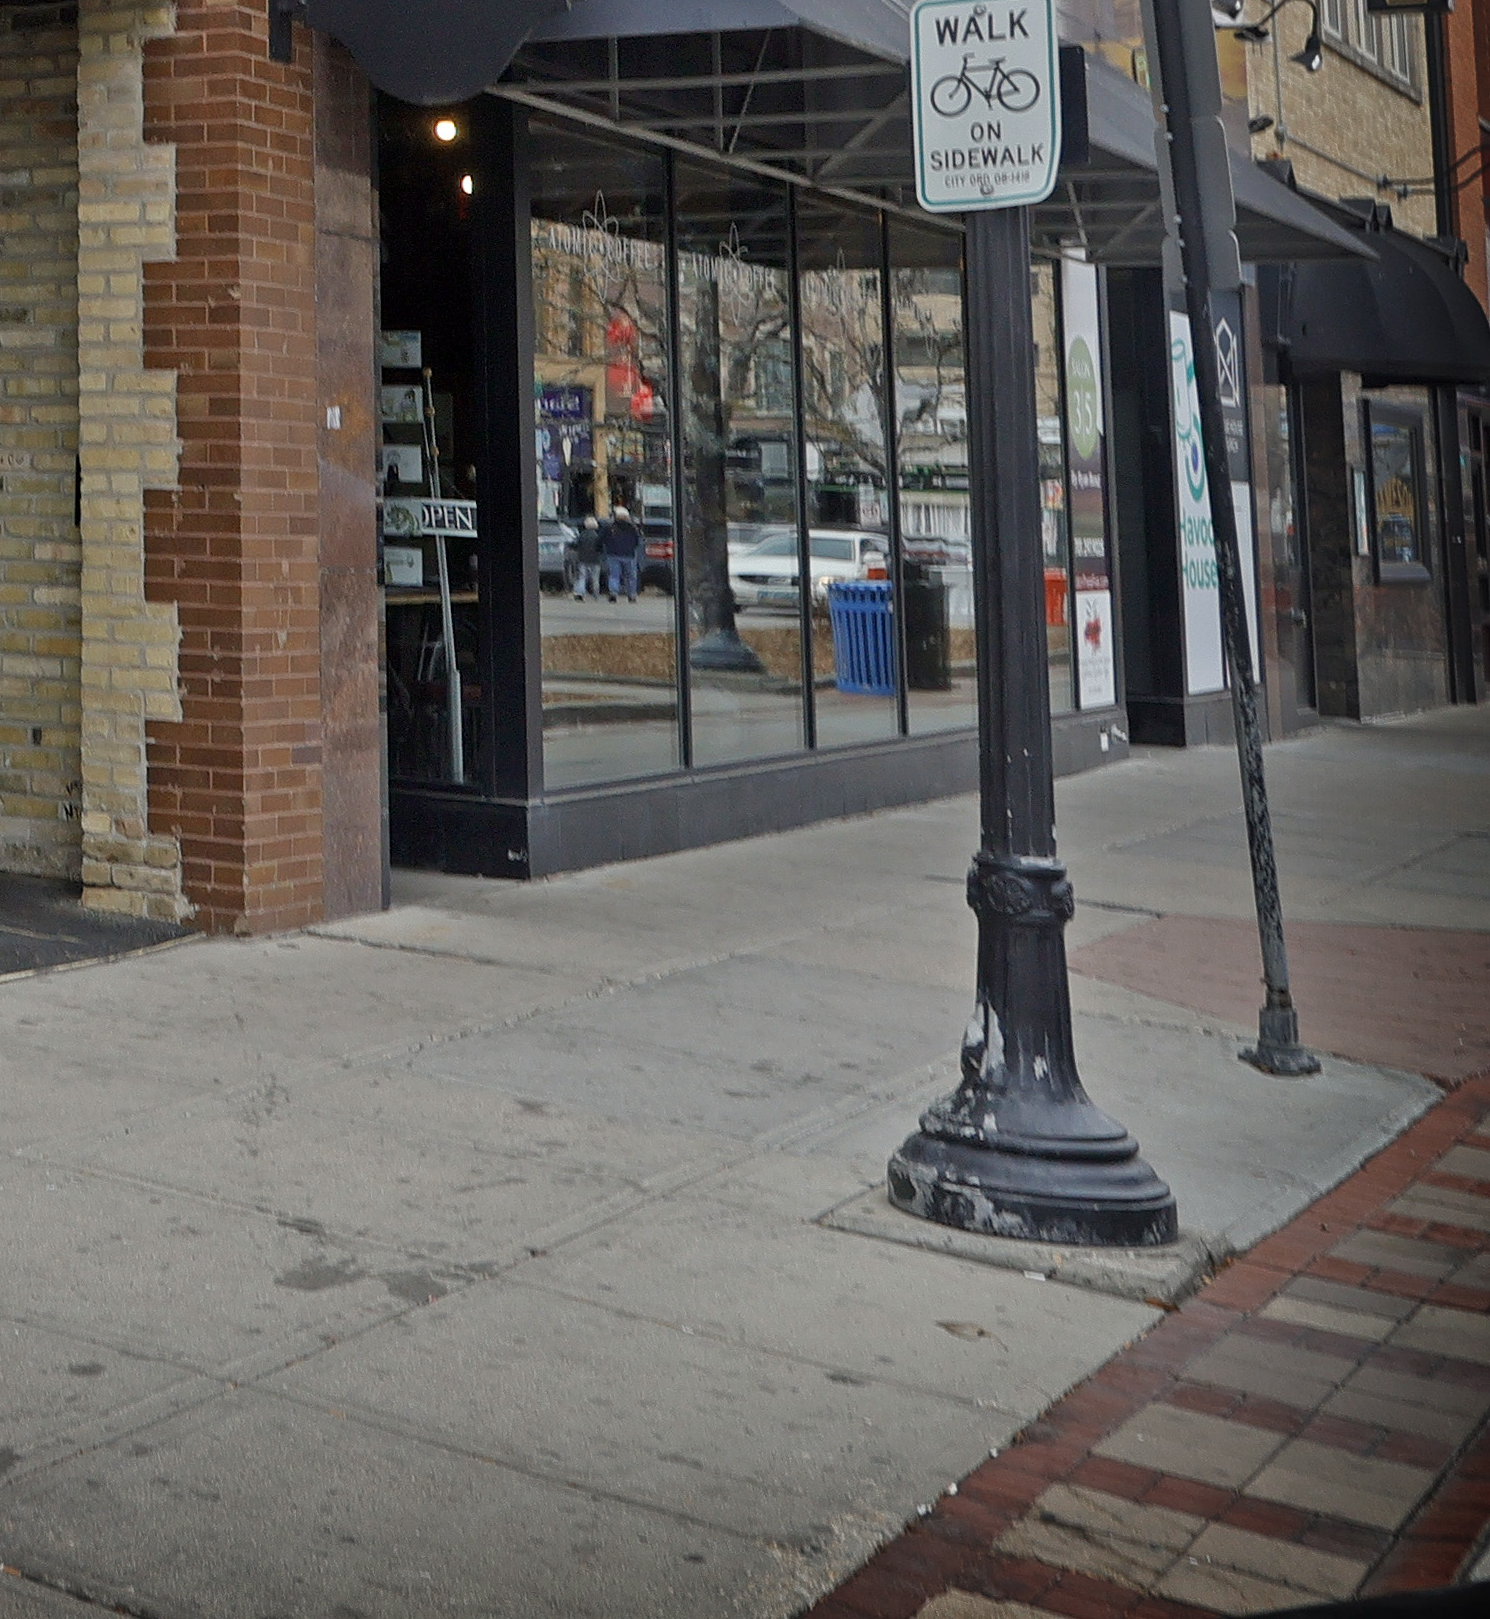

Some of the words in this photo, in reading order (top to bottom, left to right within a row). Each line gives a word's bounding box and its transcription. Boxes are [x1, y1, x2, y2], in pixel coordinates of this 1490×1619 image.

[935, 9, 1030, 47] WALK
[970, 120, 1002, 142] ON
[930, 143, 1045, 172] SIDEWALK
[944, 174, 966, 189] CITY
